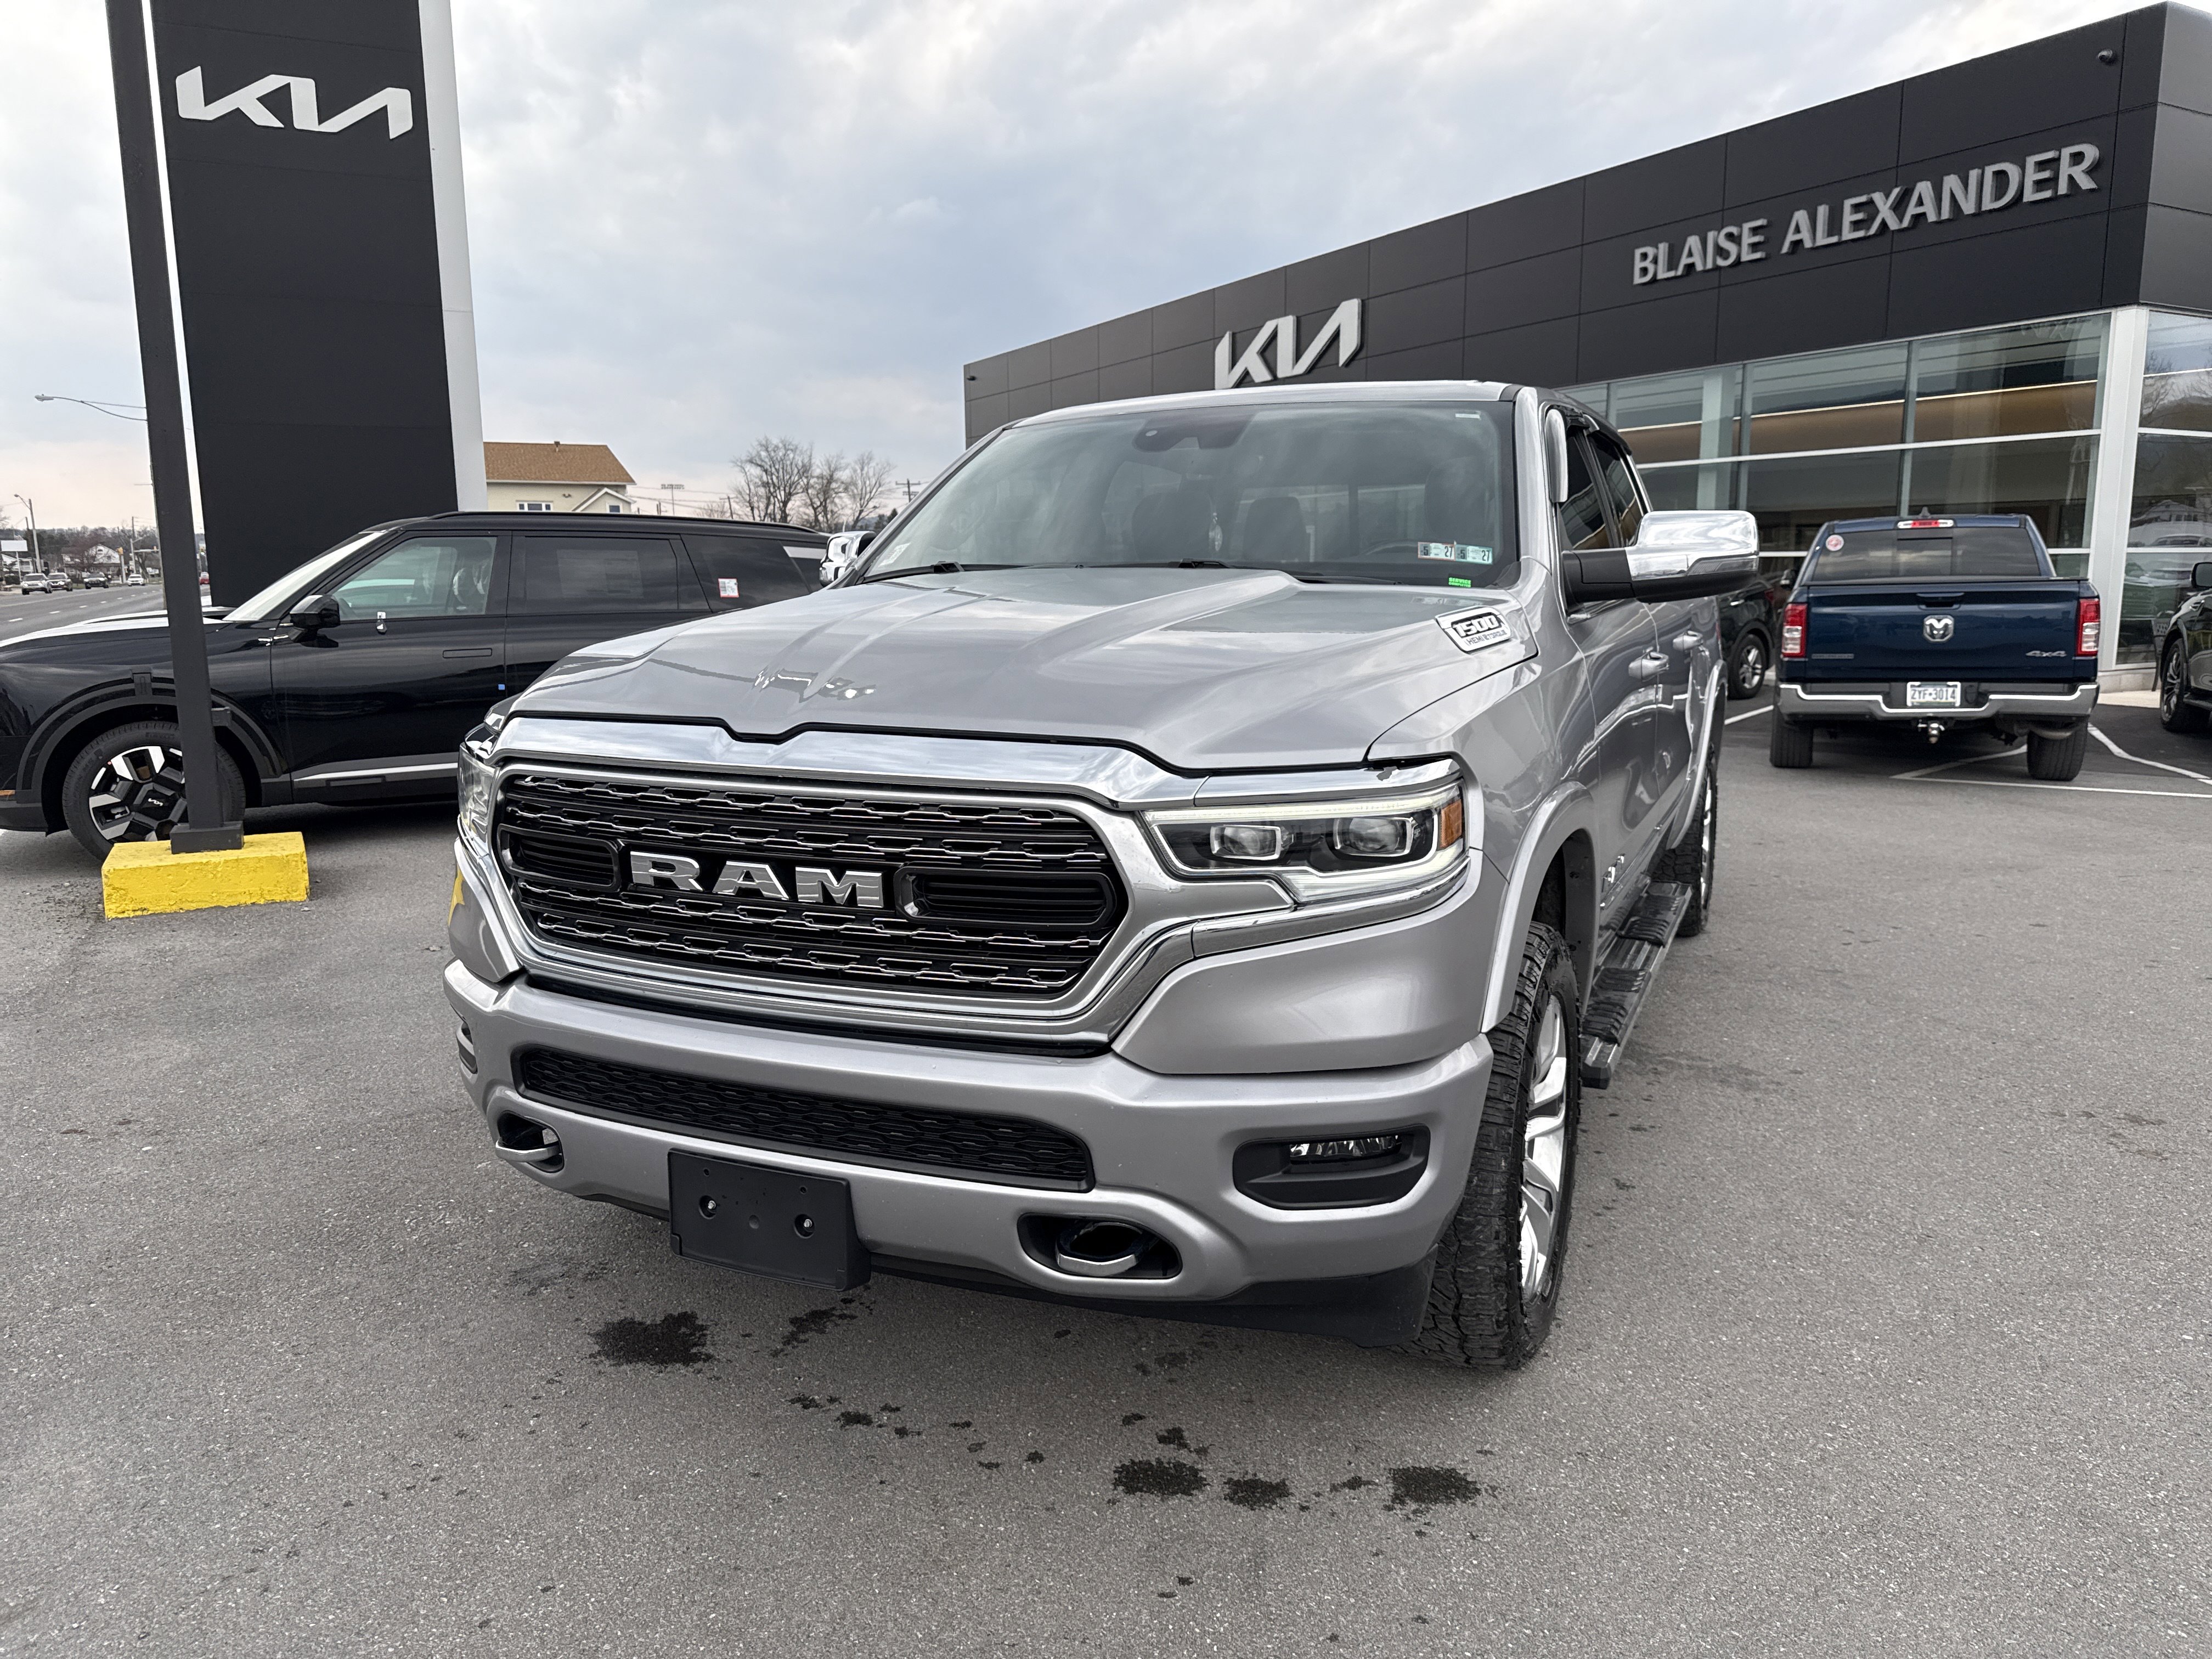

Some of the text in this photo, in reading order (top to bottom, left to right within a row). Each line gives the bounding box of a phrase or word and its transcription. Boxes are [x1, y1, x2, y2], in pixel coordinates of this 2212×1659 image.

[176, 65, 413, 139] KIA
[1633, 143, 2100, 285] BLAISE ALEXANDER
[1215, 298, 1361, 390] KIA
[1444, 546, 1453, 558] 27
[1482, 550, 1490, 562] 27
[1453, 615, 1499, 636] 1500
[1465, 635, 1485, 646] HEMI
[630, 851, 883, 908] RAM
